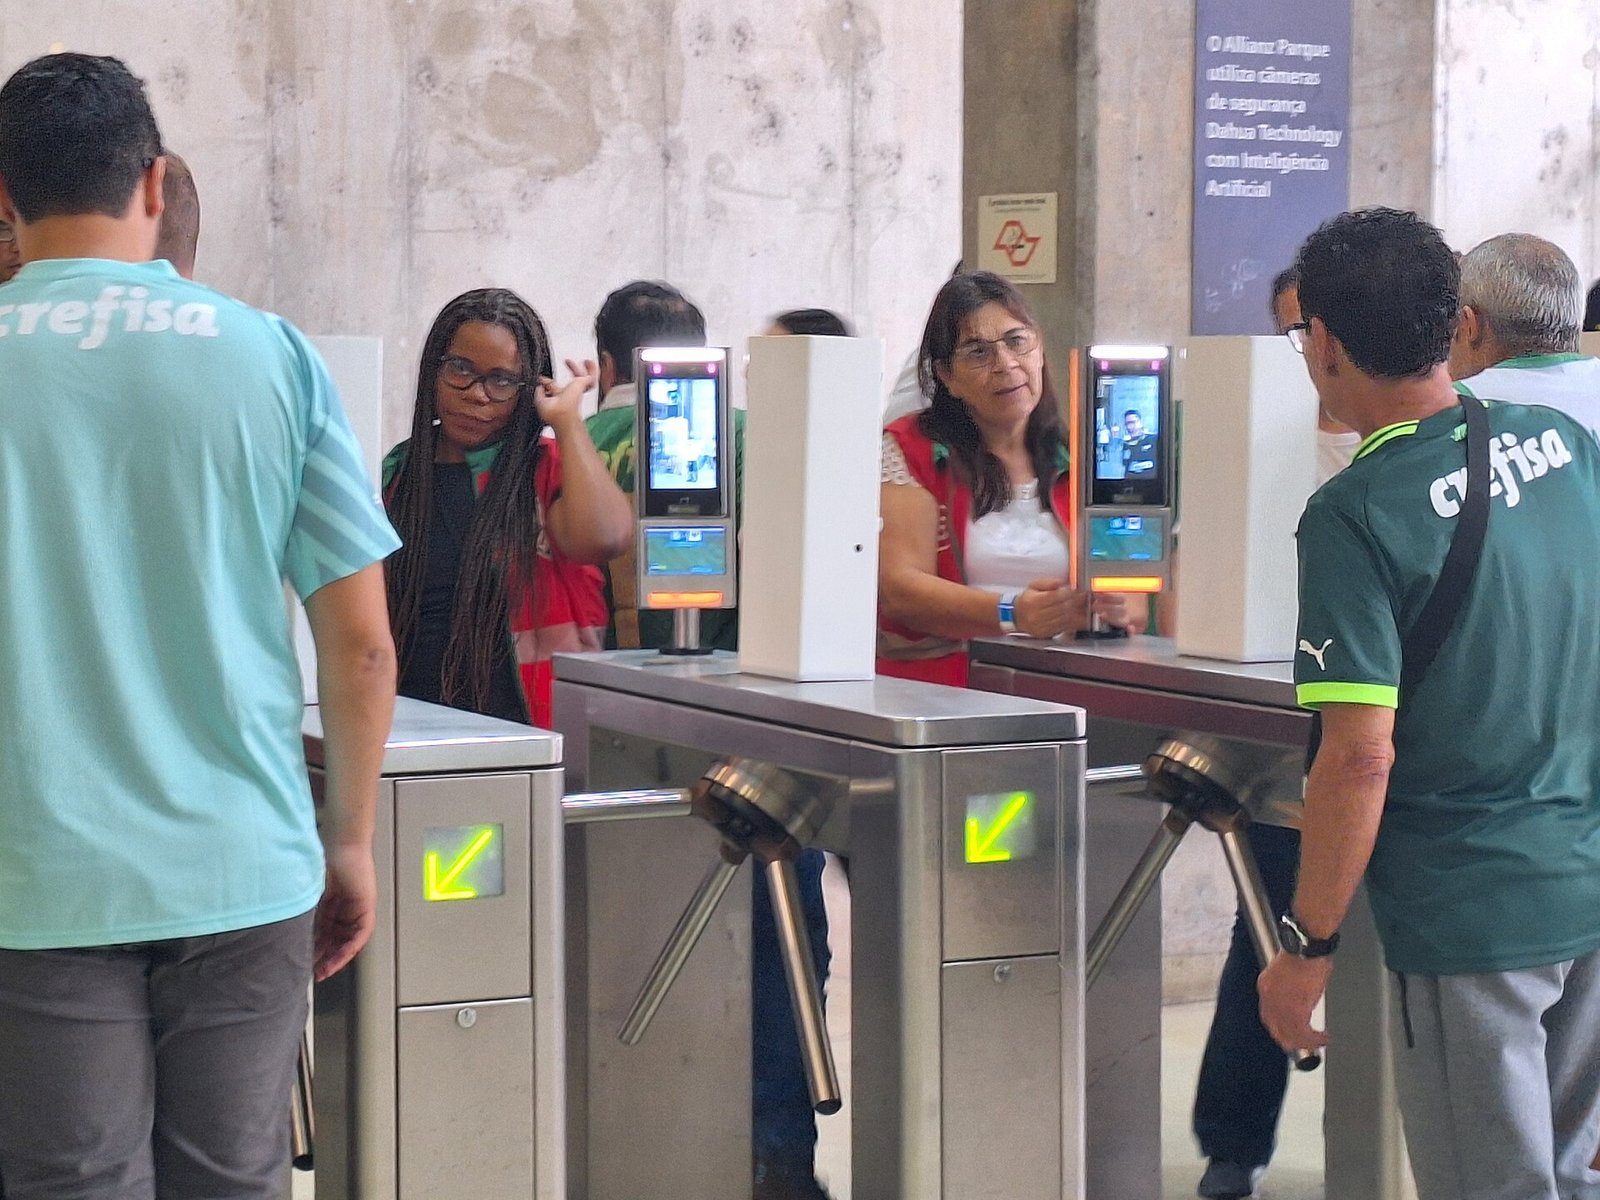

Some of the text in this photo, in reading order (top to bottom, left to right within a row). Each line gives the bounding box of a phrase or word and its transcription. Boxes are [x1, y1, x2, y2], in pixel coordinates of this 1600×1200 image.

[1205, 35, 1222, 52] O
[1275, 39, 1331, 61] Parque
[1206, 64, 1321, 85] utiliza câmeras
[1206, 92, 1307, 117] de segurança
[1257, 124, 1343, 147] Technology
[1240, 152, 1329, 174] Inteligência
[1205, 179, 1271, 197] Artificial
[1429, 428, 1573, 518] crfisa
